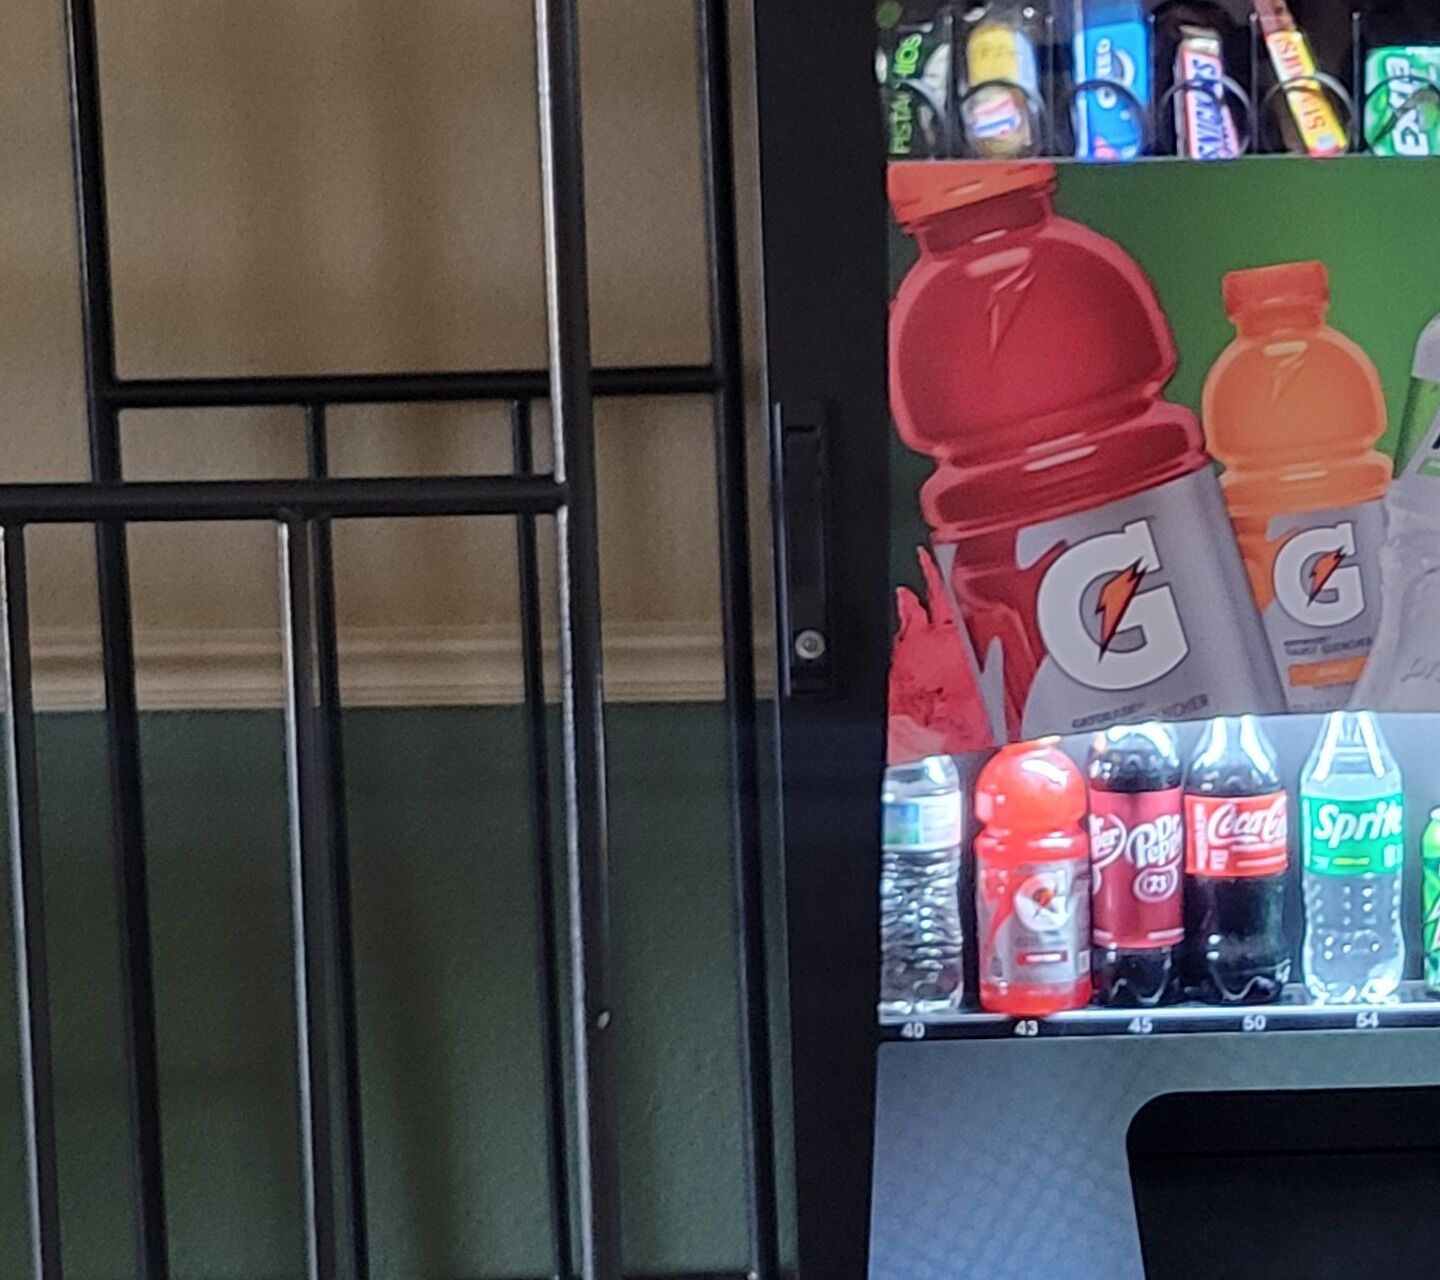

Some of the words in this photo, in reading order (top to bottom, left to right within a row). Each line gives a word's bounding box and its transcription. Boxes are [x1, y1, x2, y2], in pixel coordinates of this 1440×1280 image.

[889, 33, 923, 155] PISTAIOS
[1192, 58, 1222, 160] SNICKS
[1274, 521, 1366, 627] G
[1038, 519, 1189, 691] G
[1014, 1019, 1039, 1037] 43
[1128, 1016, 1153, 1033] 45
[1241, 1014, 1266, 1031] 50
[1355, 1011, 1380, 1028] 54
[902, 1022, 925, 1039] 40
